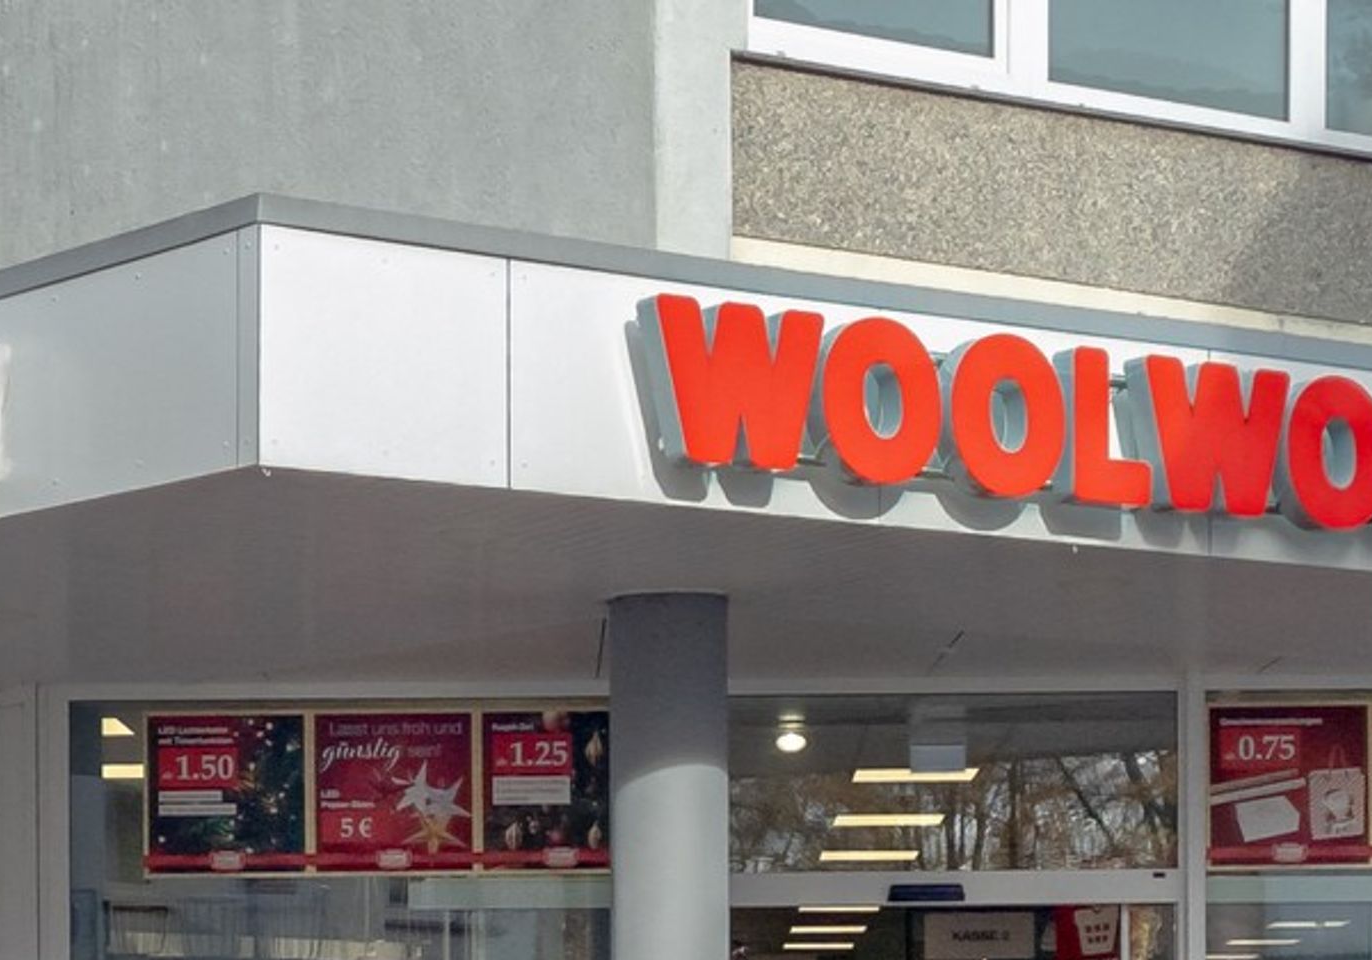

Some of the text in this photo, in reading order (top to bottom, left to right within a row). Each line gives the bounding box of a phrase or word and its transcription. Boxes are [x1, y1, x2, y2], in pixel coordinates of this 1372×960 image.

[319, 736, 401, 773] günstig
[510, 740, 569, 767] 1.25
[1238, 734, 1296, 761] 0.75
[175, 754, 235, 781] 1.50
[340, 817, 373, 838] 5 €
